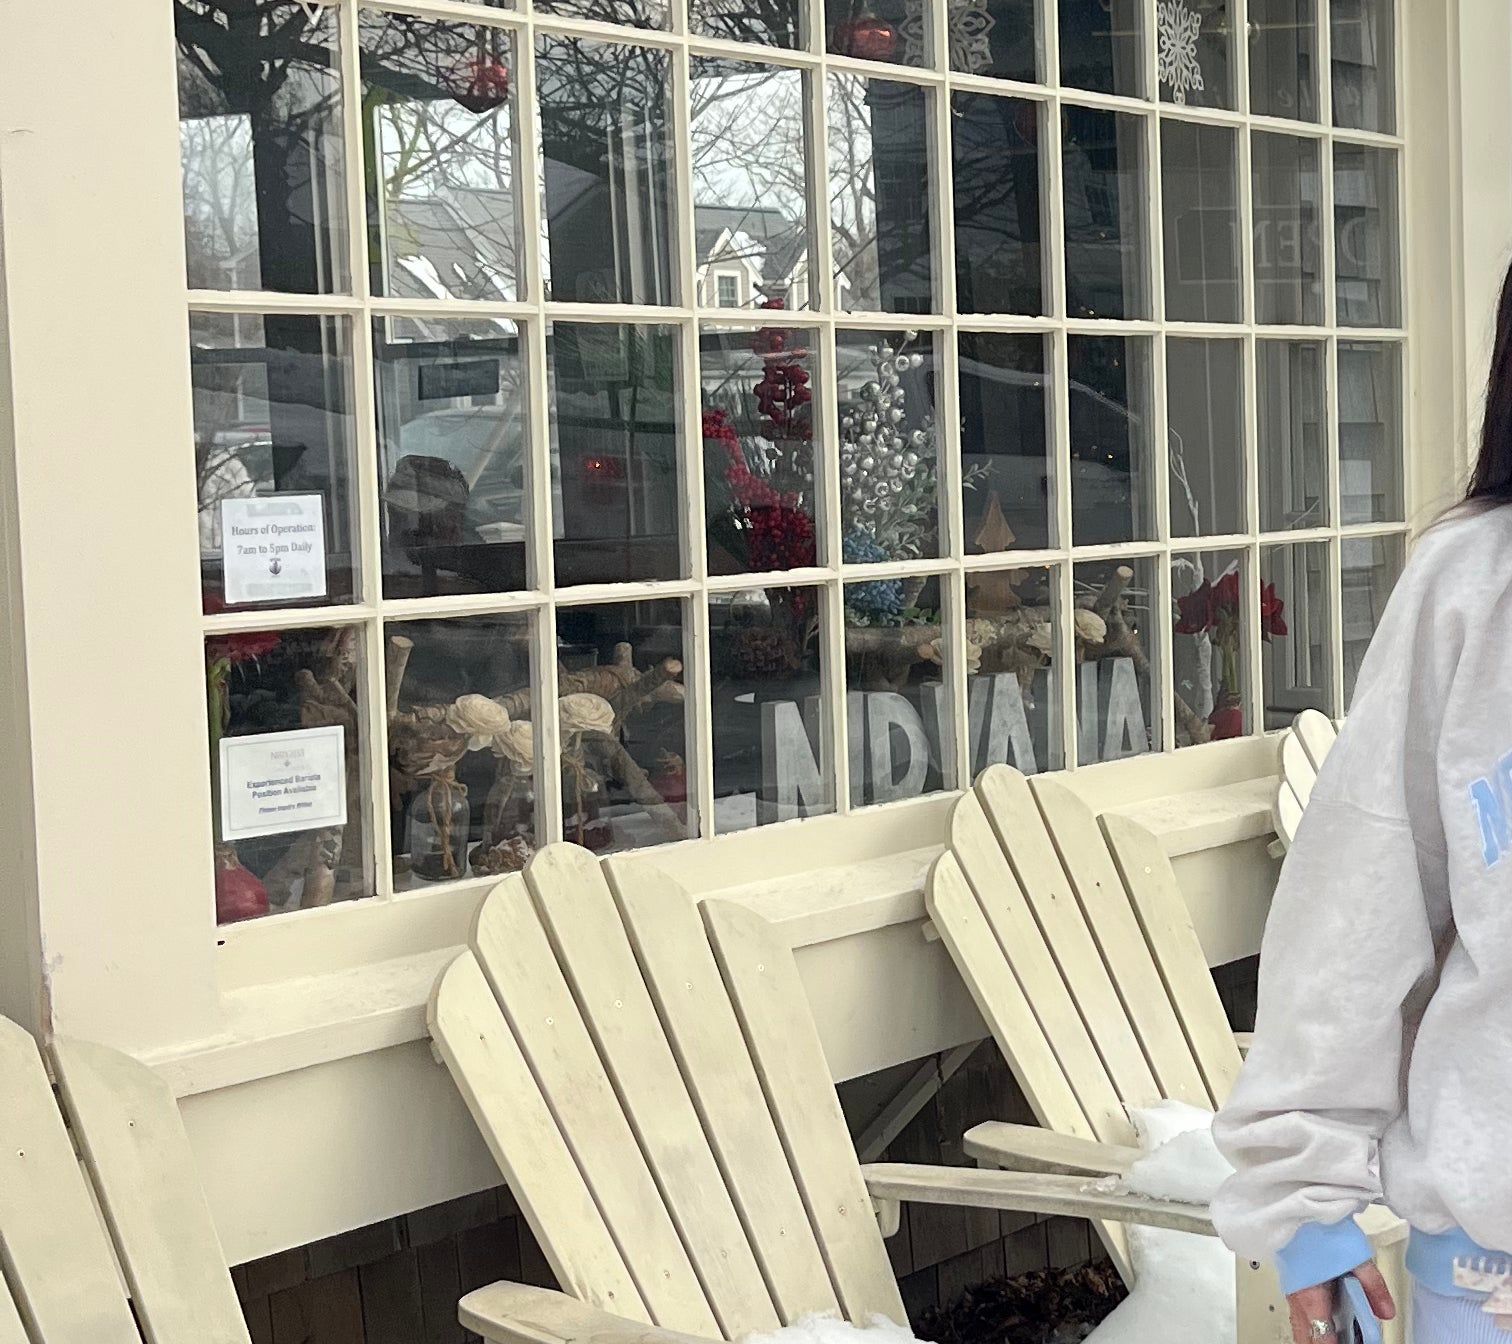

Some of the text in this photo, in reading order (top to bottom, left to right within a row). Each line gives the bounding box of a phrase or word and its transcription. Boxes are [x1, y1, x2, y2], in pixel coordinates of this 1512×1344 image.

[232, 526, 258, 536] Hours
[260, 524, 270, 534] of
[237, 541, 312, 555] 7am to 5pm Daily
